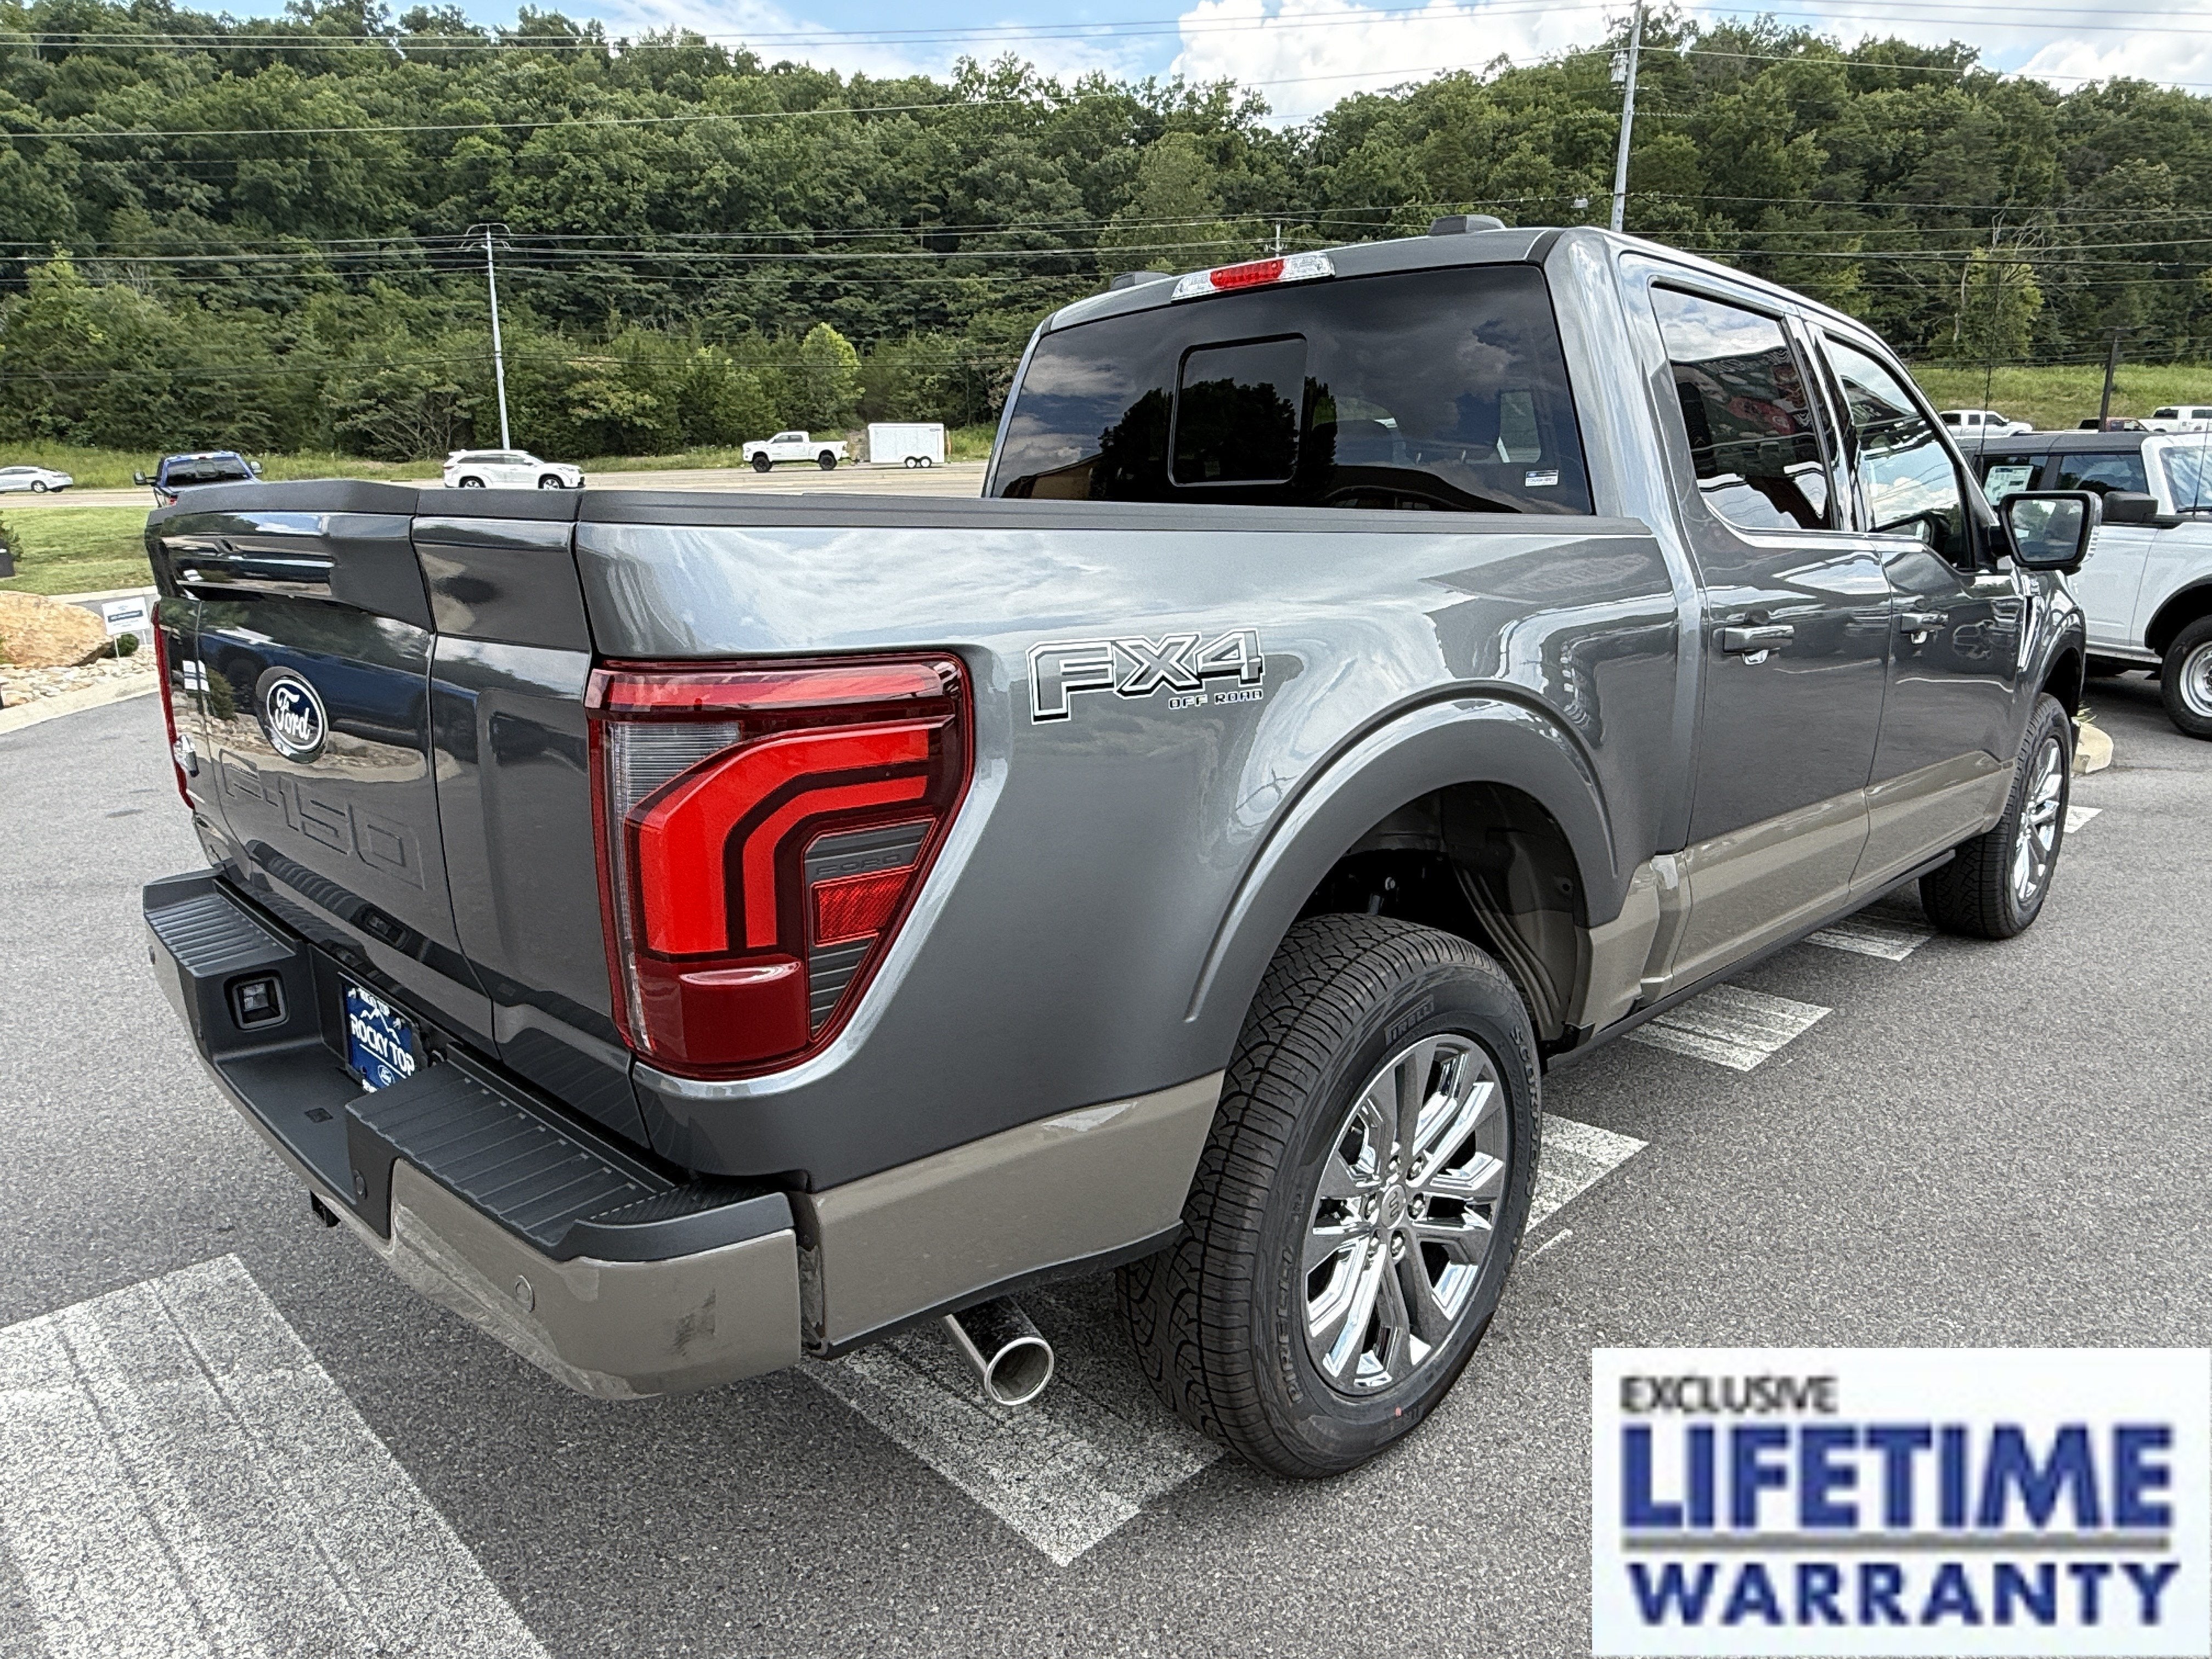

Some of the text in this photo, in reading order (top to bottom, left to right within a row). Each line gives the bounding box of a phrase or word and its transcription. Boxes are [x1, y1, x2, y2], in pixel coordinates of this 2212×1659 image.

[1026, 628, 1265, 724] FX4
[1169, 689, 1262, 709] OFF ROAD
[276, 687, 310, 740] Ford
[816, 854, 901, 874] FORD
[350, 1013, 388, 1058] ROCKY
[389, 1041, 415, 1076] TOP
[1277, 1248, 1303, 1404] PIRELLI
